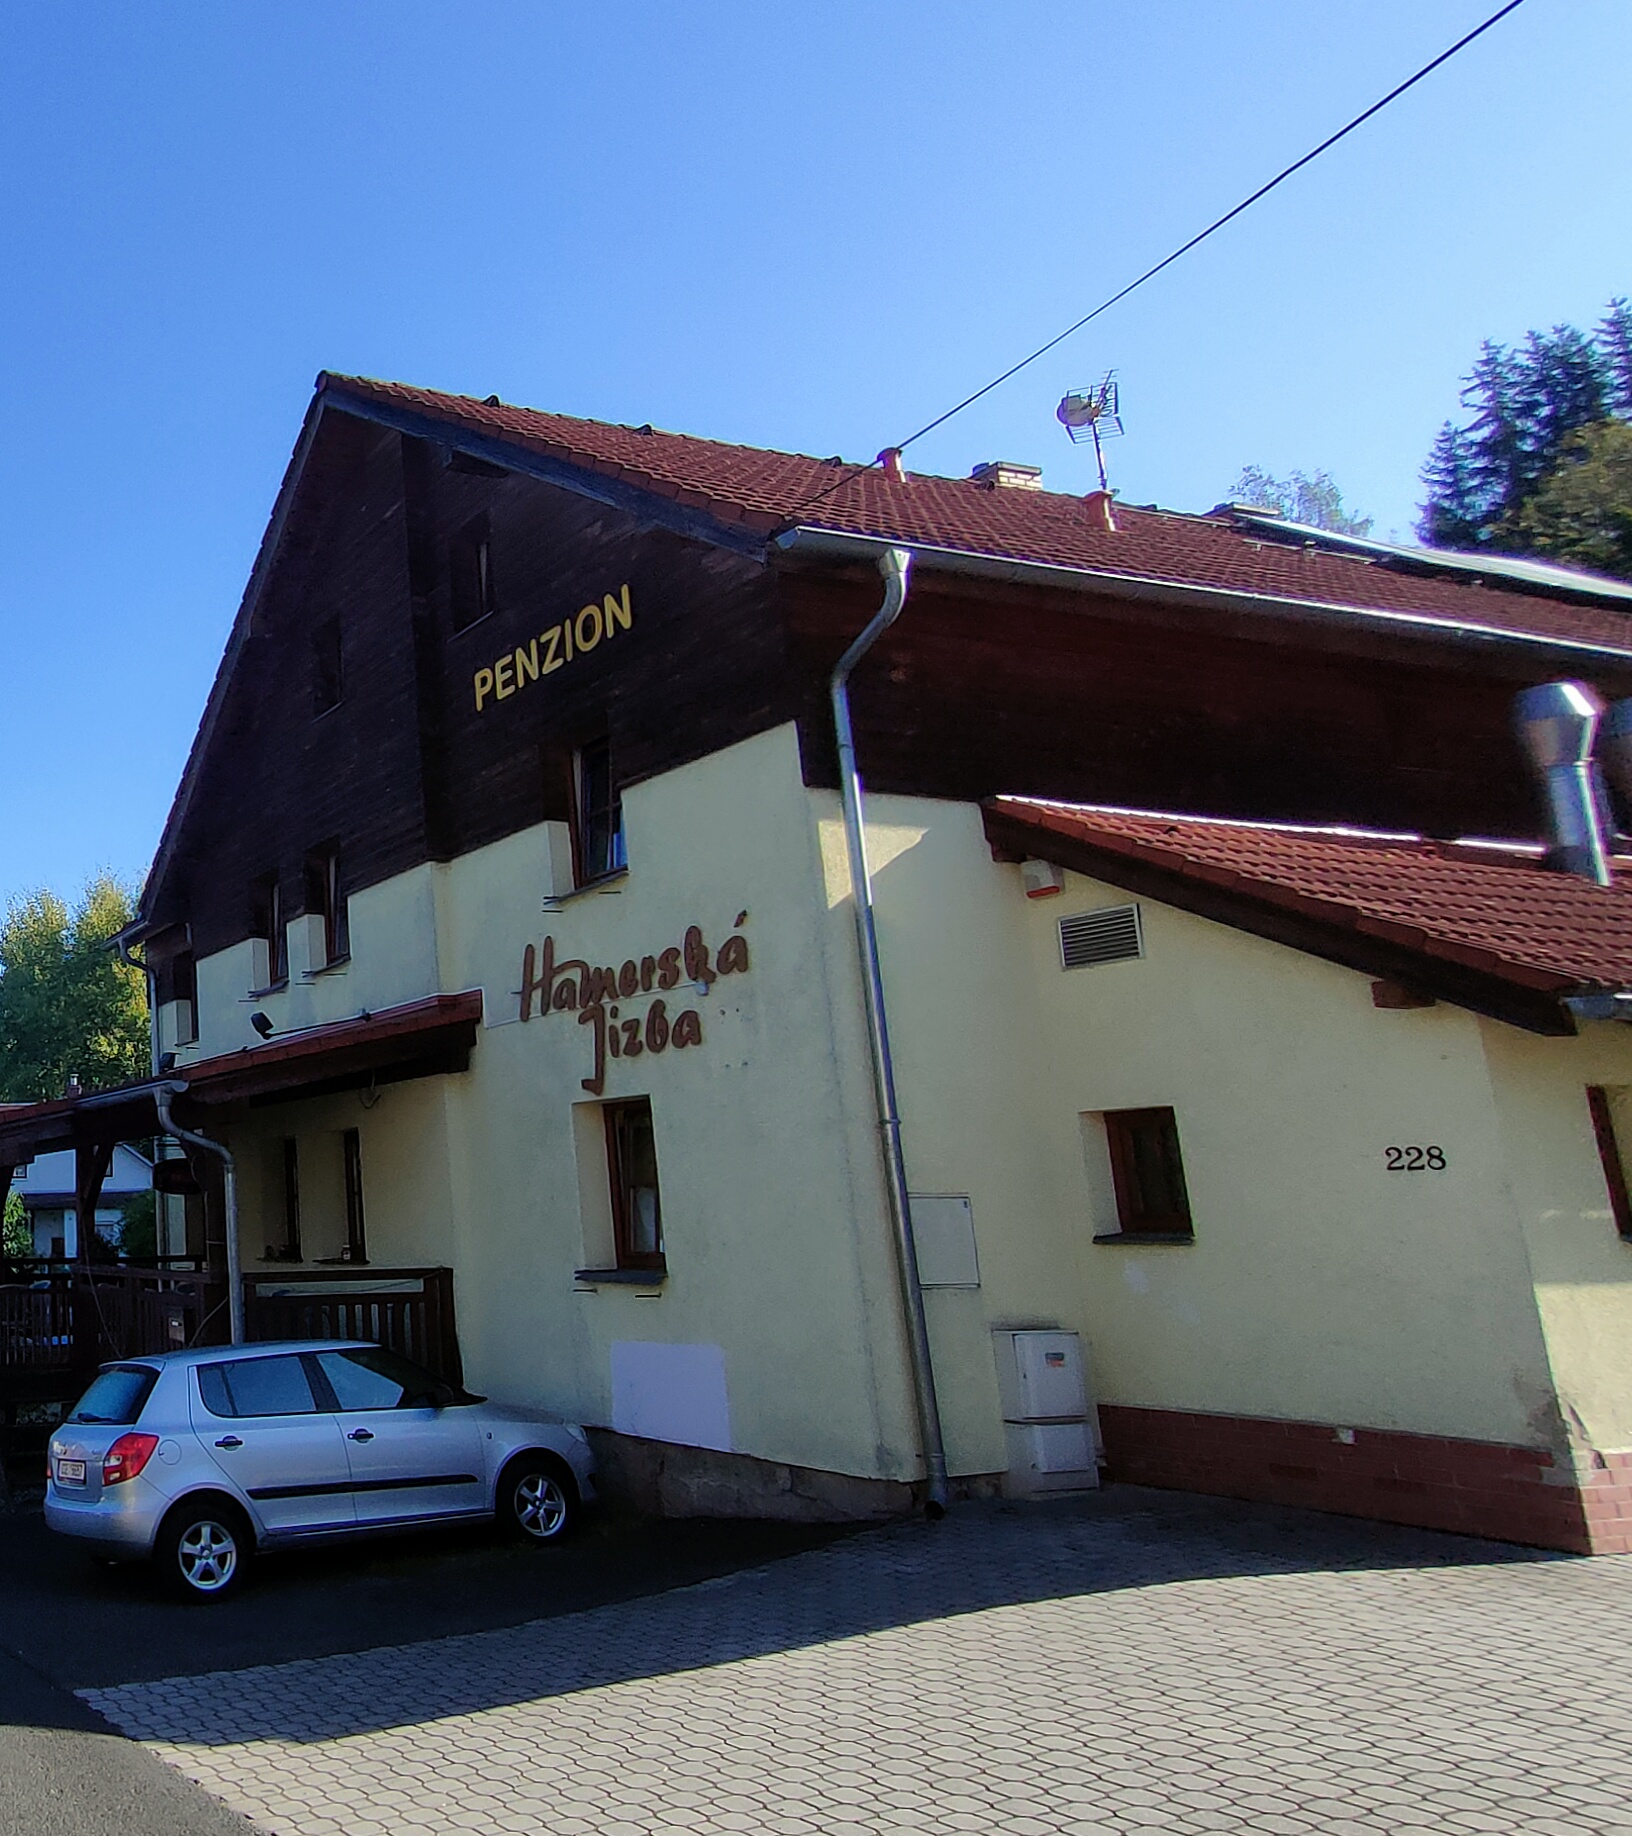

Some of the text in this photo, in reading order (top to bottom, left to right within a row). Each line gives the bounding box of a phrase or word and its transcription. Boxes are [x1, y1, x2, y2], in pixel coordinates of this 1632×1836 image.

[474, 584, 632, 711] PENZION
[519, 909, 749, 1022] Hamerská
[578, 999, 701, 1096] Jizba
[1385, 1145, 1446, 1171] 228
